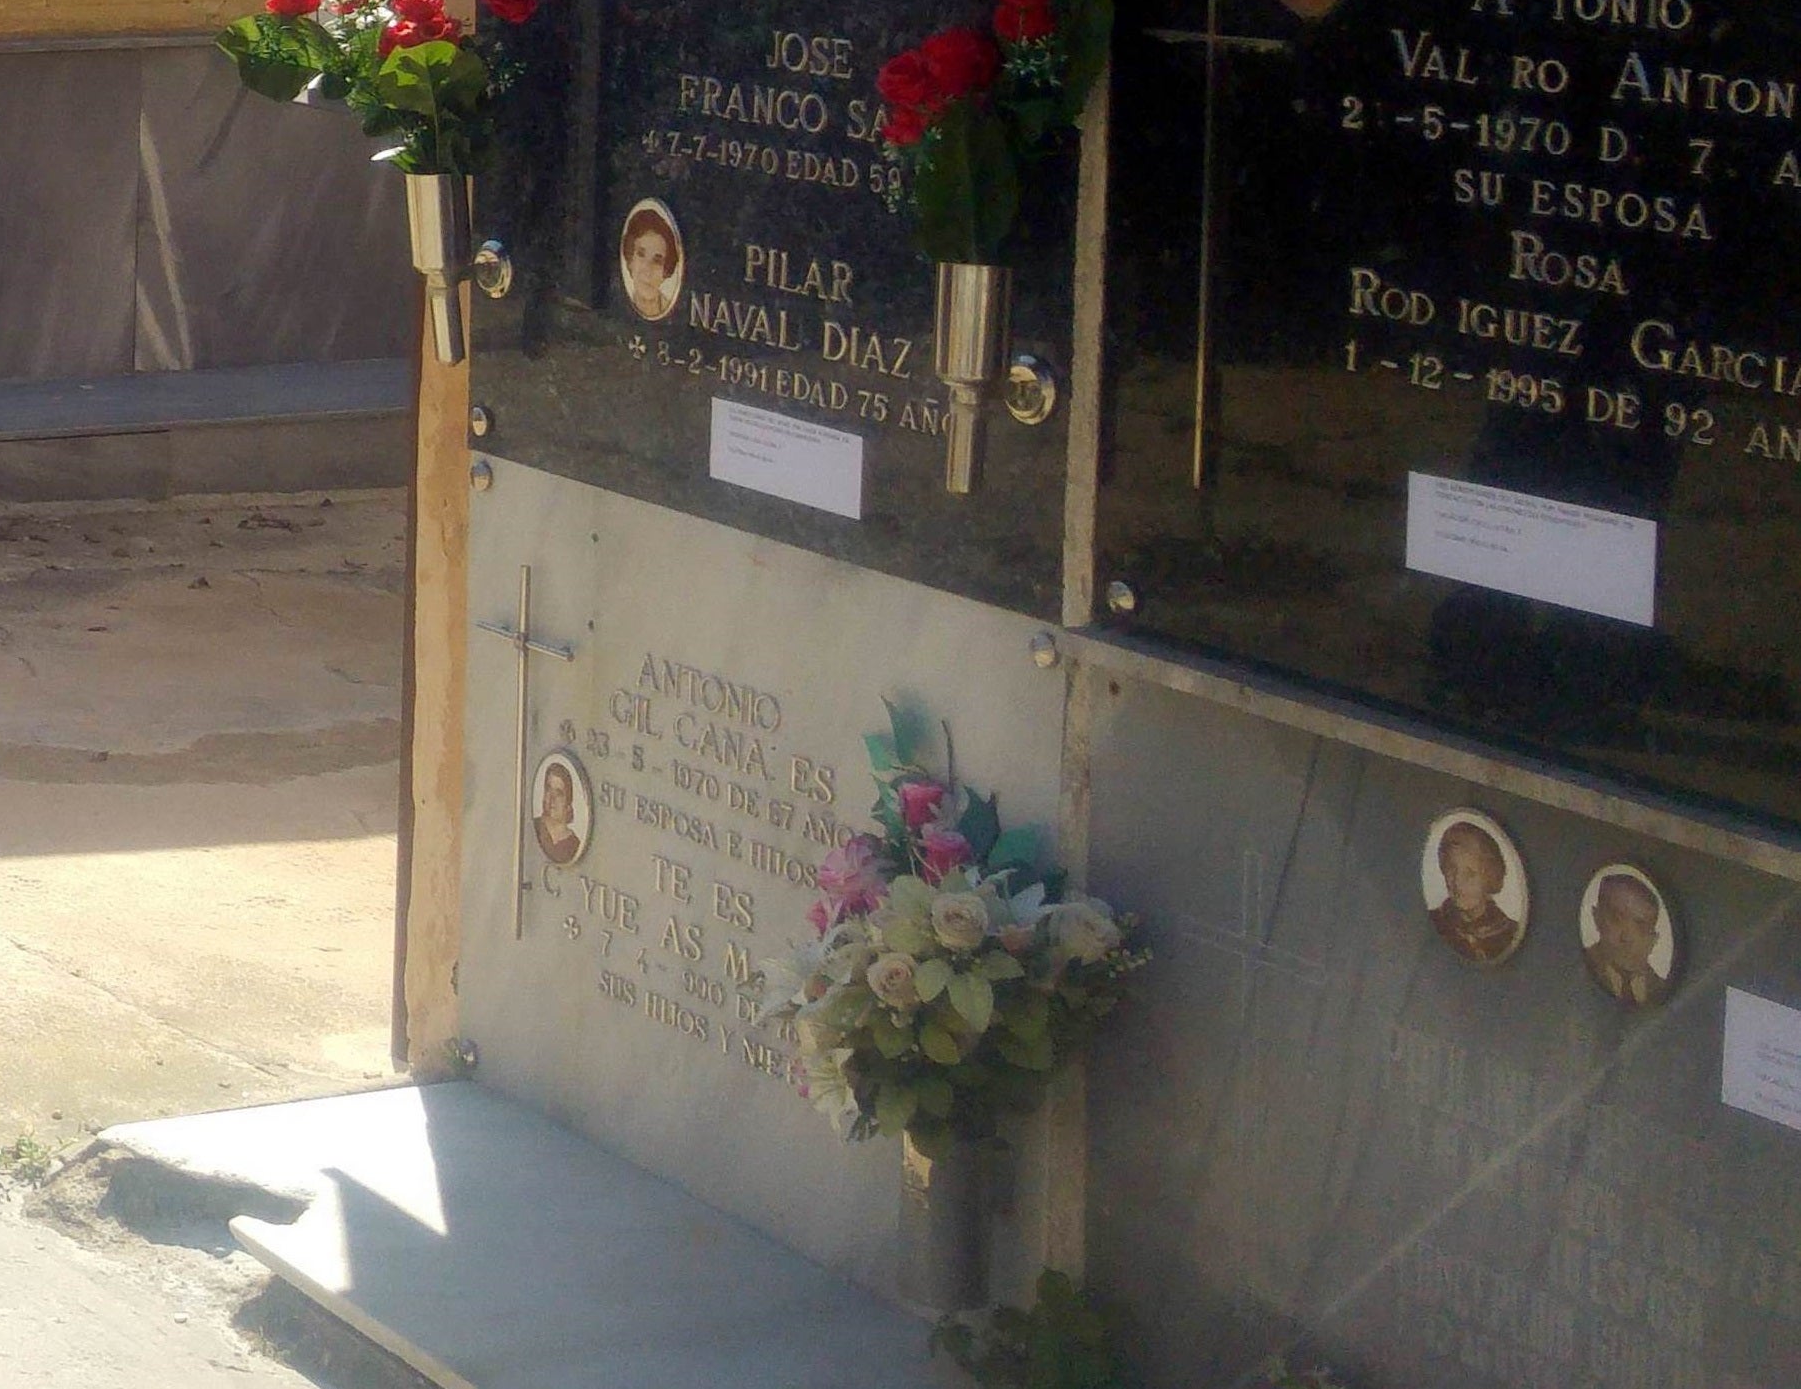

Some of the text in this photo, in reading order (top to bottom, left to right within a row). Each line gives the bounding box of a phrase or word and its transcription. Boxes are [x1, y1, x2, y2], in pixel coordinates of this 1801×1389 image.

[766, 30, 853, 79] JOSE
[679, 75, 827, 132] FRANCO
[786, 150, 859, 187] EDAD
[1453, 168, 1712, 240] SU ESPOSA
[745, 244, 854, 304] PILAR
[689, 290, 912, 379] NAVAL DIAZ
[776, 370, 848, 410] EDAD
[857, 389, 890, 422] 75
[1586, 386, 1640, 430] DE
[1663, 403, 1716, 445] 92
[609, 689, 661, 740] GIL
[636, 653, 782, 733] ANTONIO
[601, 781, 625, 811] SU
[635, 794, 718, 851] ESPOSA
[727, 831, 742, 859] E
[600, 971, 636, 1007] SUS
